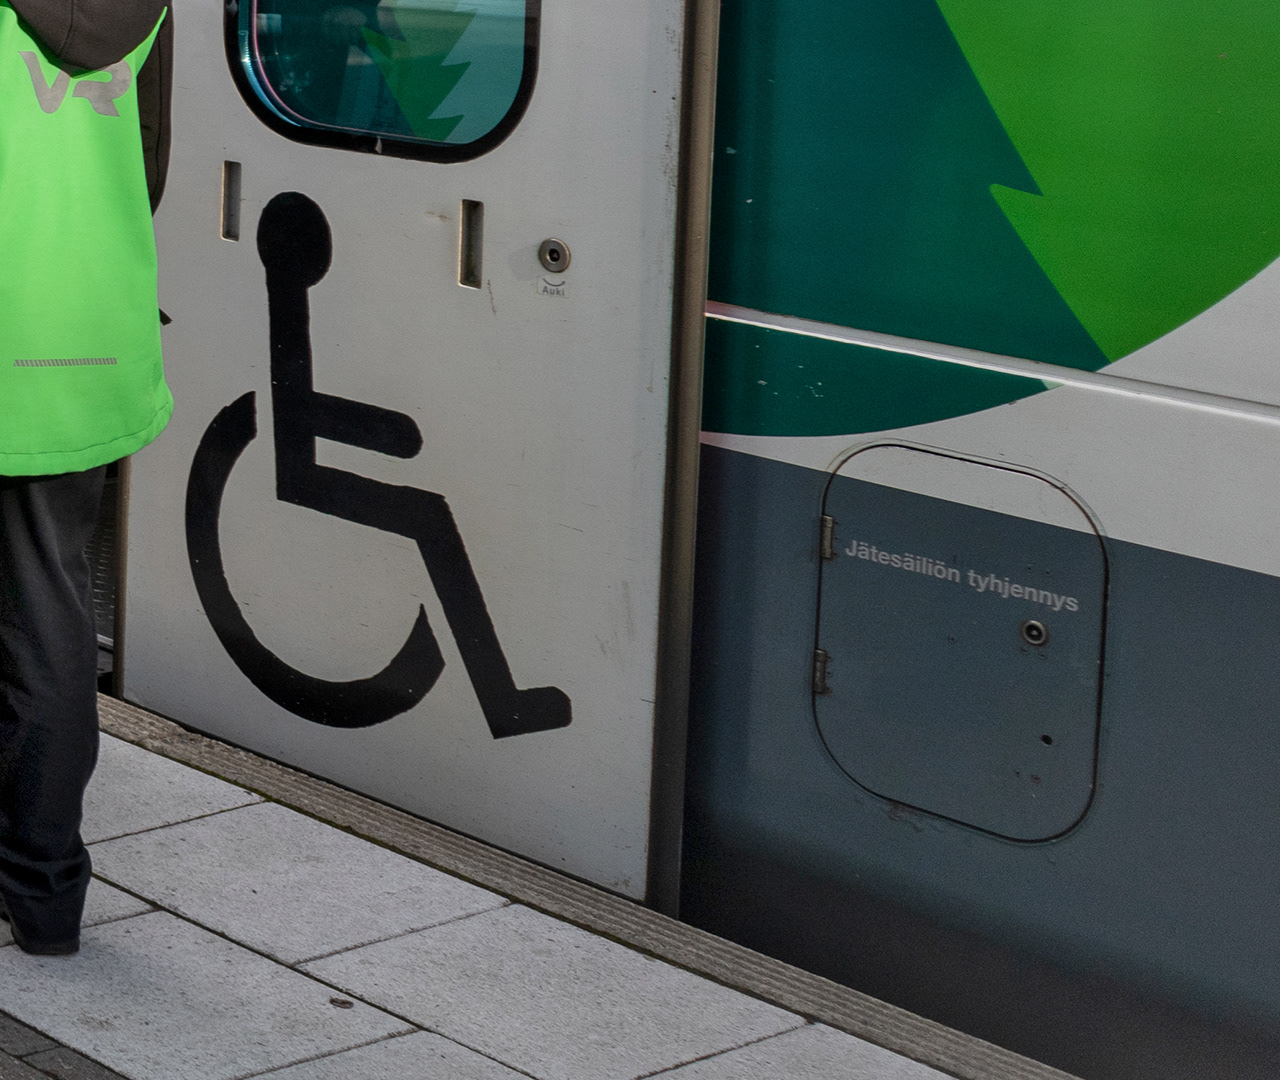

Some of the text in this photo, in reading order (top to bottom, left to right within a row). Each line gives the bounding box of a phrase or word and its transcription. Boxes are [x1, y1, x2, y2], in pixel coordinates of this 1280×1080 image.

[19, 51, 133, 117] VR
[542, 286, 566, 297] Auki
[844, 539, 1079, 612] Jätesäiliön tyhjennys
